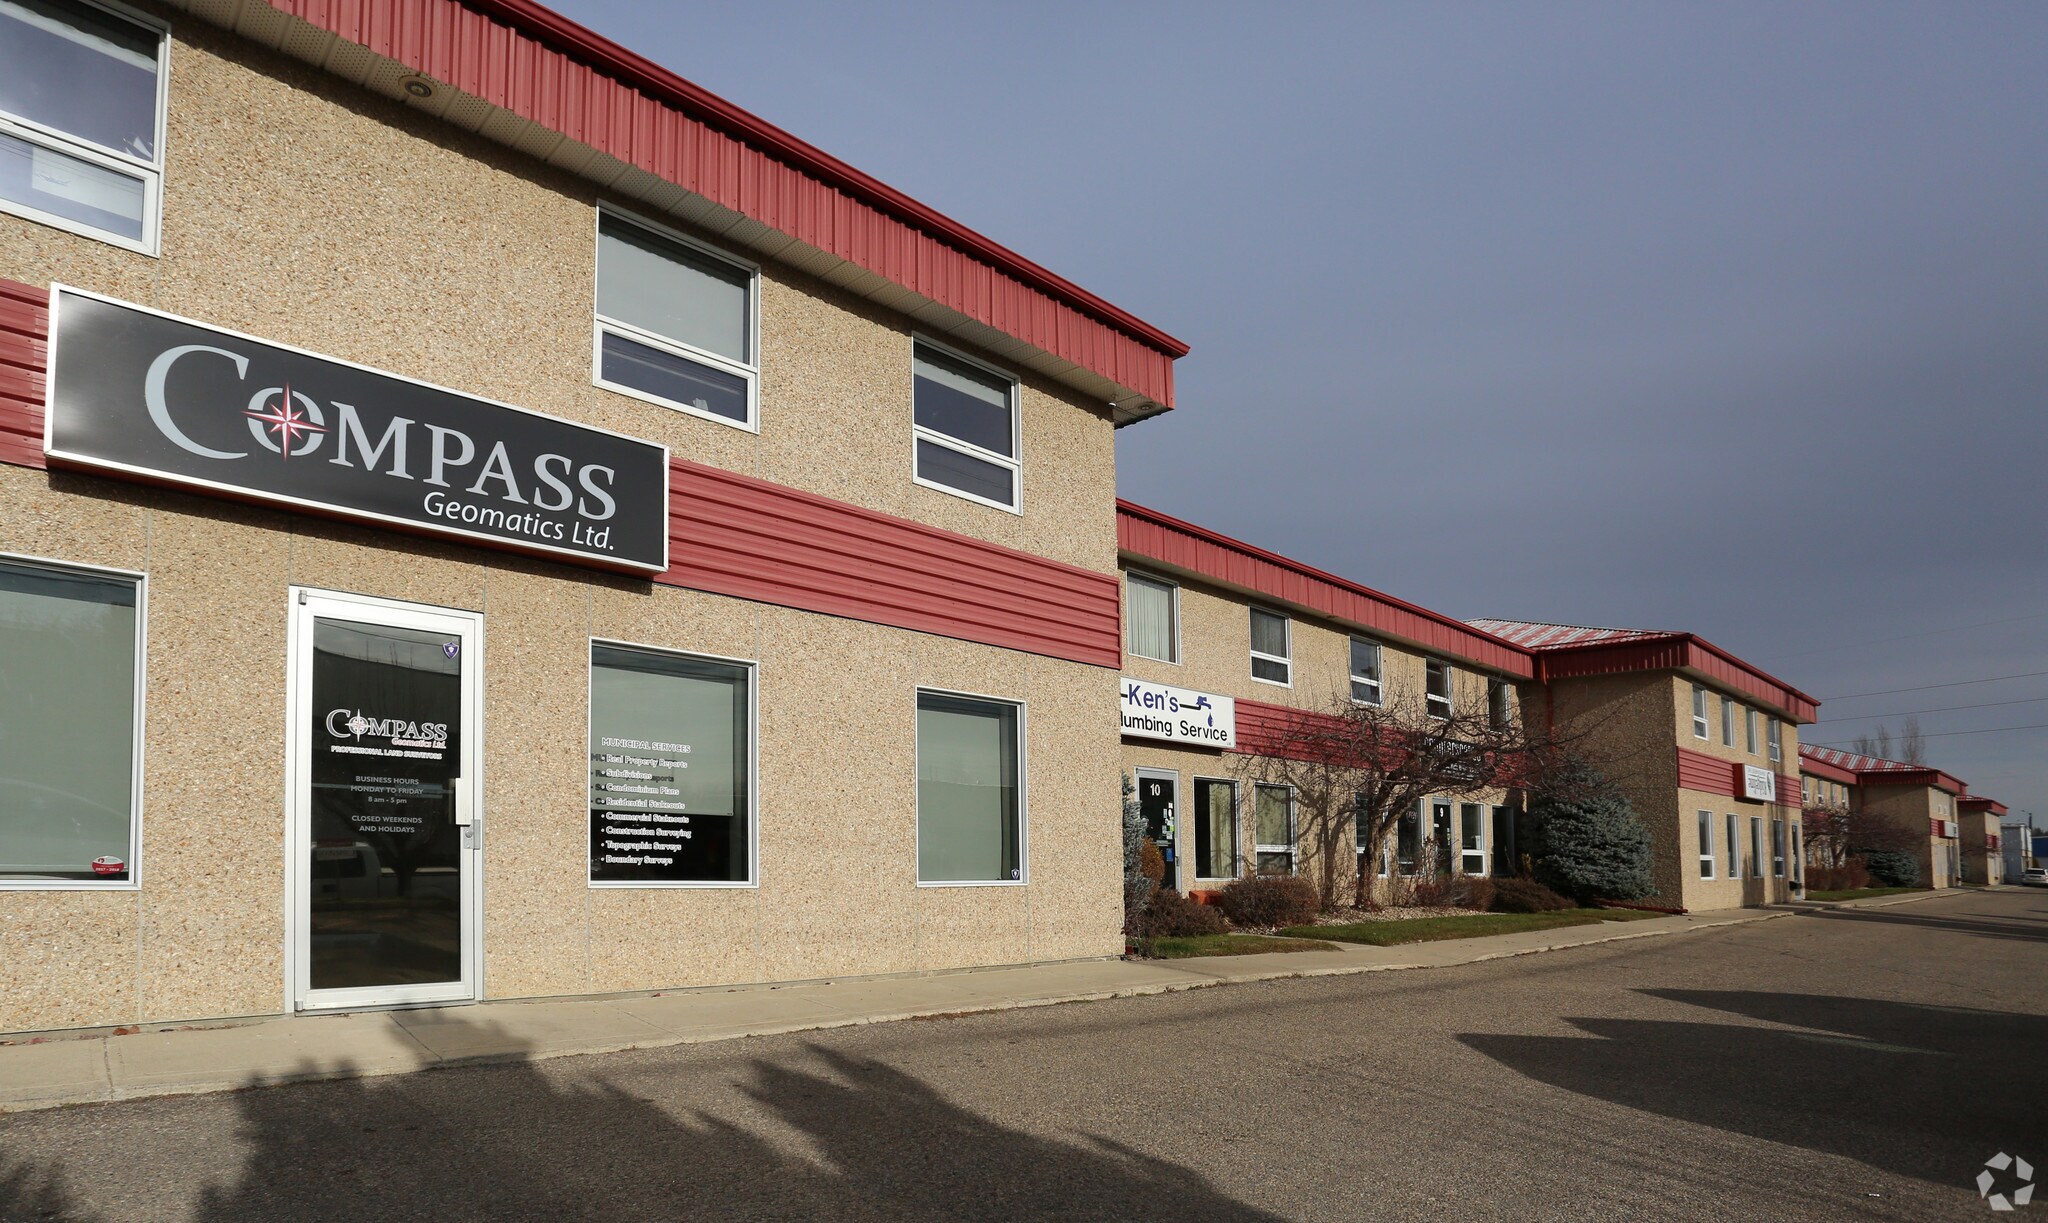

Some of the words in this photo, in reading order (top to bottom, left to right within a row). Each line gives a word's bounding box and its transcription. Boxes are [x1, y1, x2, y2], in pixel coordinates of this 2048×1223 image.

[144, 344, 618, 521] COMPASS
[423, 491, 565, 541] Geomatics
[571, 521, 615, 551] Ltd.
[1128, 683, 1179, 713] Ken's
[325, 708, 448, 742] COMPASS
[1120, 710, 1172, 737] lumbing
[1180, 719, 1228, 741] Service
[391, 737, 432, 748] Geomatics
[601, 736, 651, 750] MUNICIPAL
[652, 742, 691, 754] SERVICES
[606, 754, 624, 764] Real
[625, 755, 658, 768] Property
[659, 758, 688, 769] Reports
[355, 775, 392, 784] BUSINESS
[393, 777, 419, 785] HOURS
[605, 768, 653, 780] Subdivisions
[350, 785, 385, 793] MONDAY
[385, 786, 397, 794] TO
[398, 787, 424, 795] FRIDAY
[605, 782, 659, 795] Condominium
[660, 786, 680, 796] Plans
[1150, 783, 1161, 796] 10
[605, 797, 648, 808] Residential
[649, 798, 686, 810] Stakeouts
[382, 816, 423, 824] WEEKENDS
[605, 811, 652, 823] Commercial
[652, 812, 690, 824] Stakeouts
[605, 825, 655, 837] Construction
[656, 827, 692, 839] Surveying
[605, 840, 652, 851] Topographic
[653, 842, 682, 853] Surveys
[605, 855, 644, 866] Boundary
[644, 855, 674, 866] Surveys
